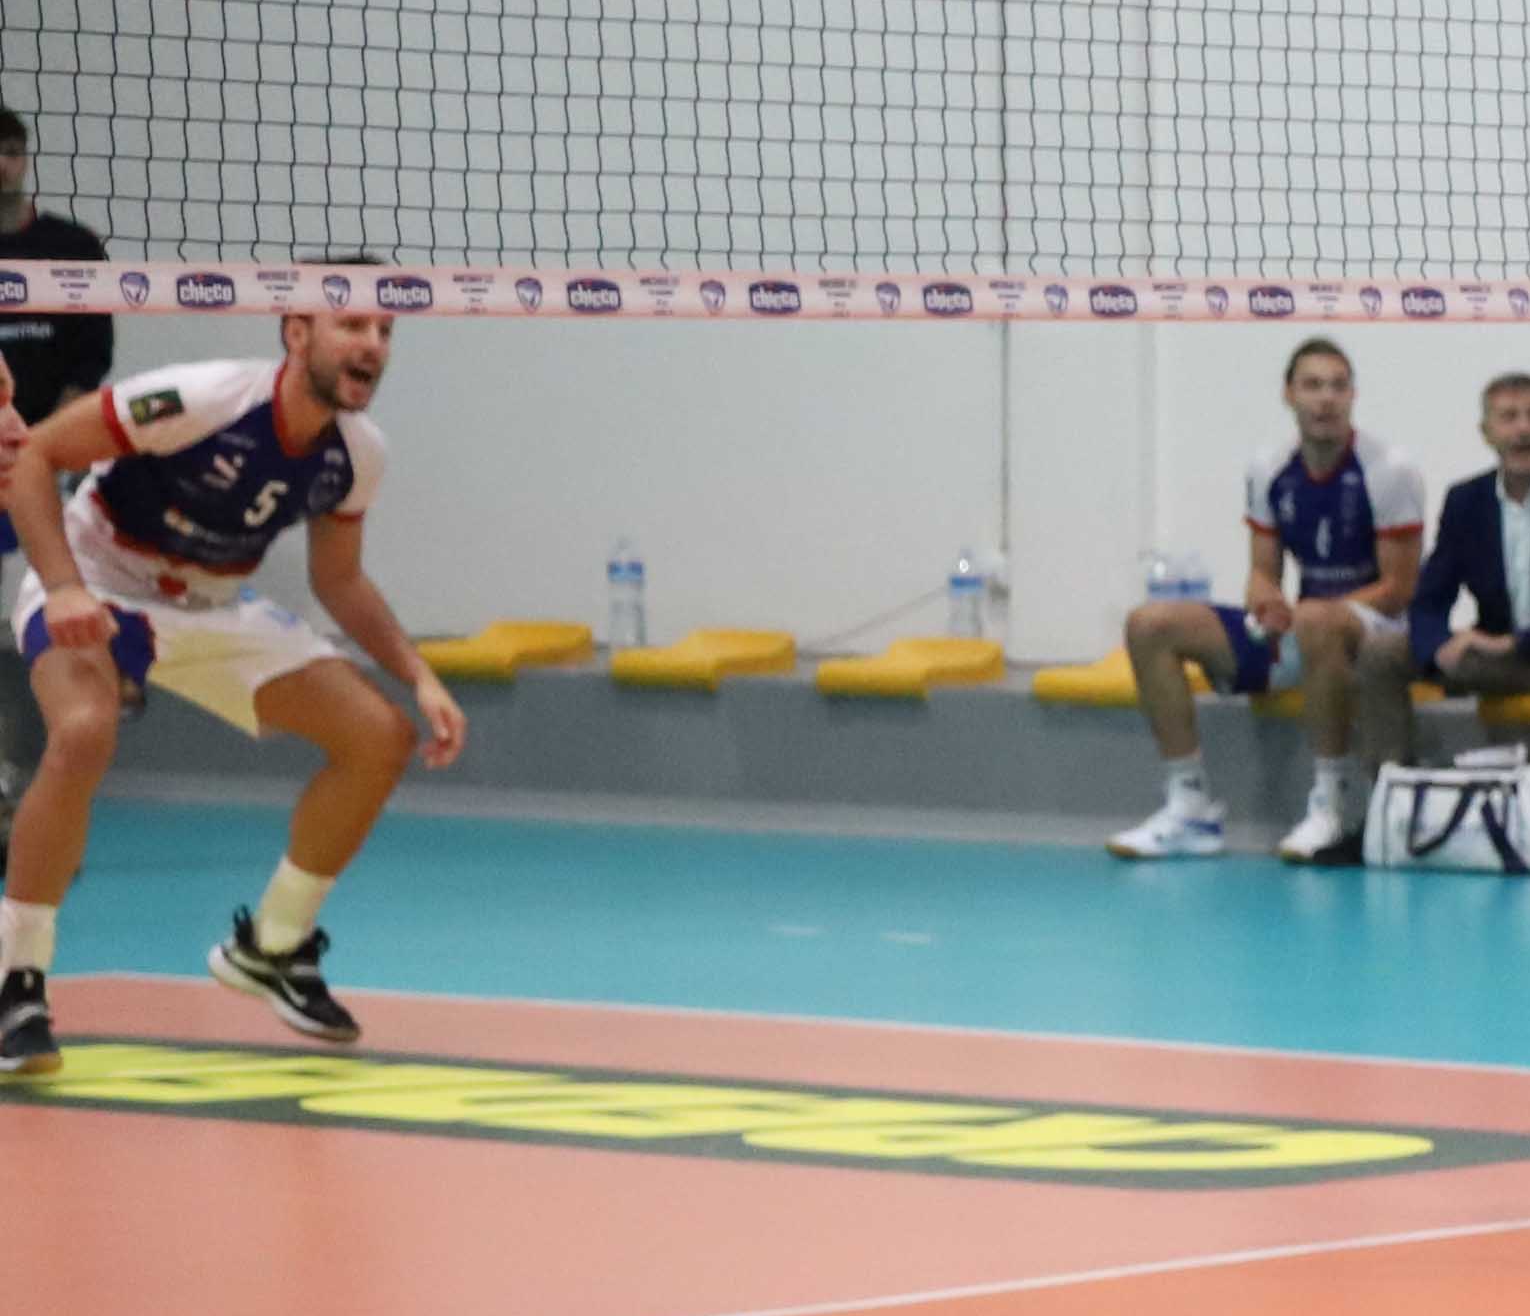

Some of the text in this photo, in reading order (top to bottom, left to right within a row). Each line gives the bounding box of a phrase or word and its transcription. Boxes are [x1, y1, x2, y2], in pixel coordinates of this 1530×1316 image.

[180, 279, 233, 305] chicco
[379, 281, 431, 307] chicco
[571, 284, 620, 309] chicco
[244, 479, 289, 527] 5
